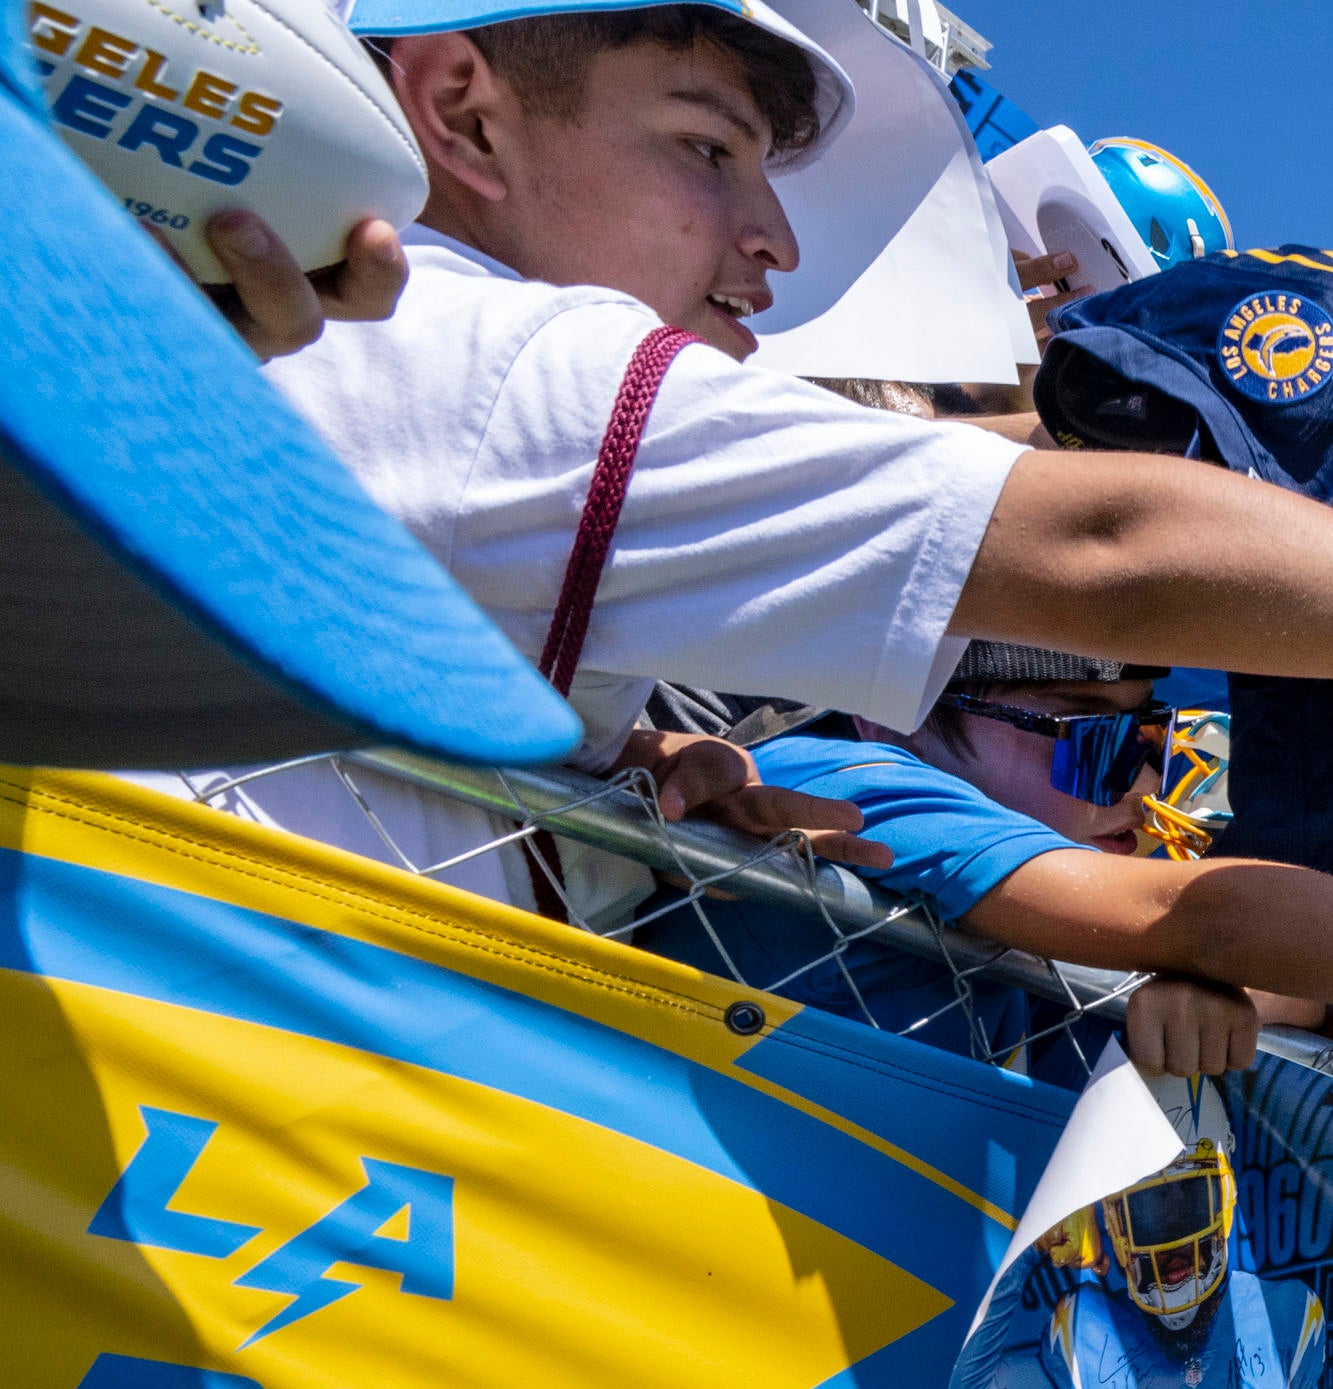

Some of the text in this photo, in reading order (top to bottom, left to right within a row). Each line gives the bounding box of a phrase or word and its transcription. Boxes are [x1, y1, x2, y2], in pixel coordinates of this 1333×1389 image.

[36, 60, 264, 186] ERS
[123, 198, 189, 230] 1960
[1221, 295, 1302, 381] LOS ANGELES
[86, 1103, 456, 1354] LA
